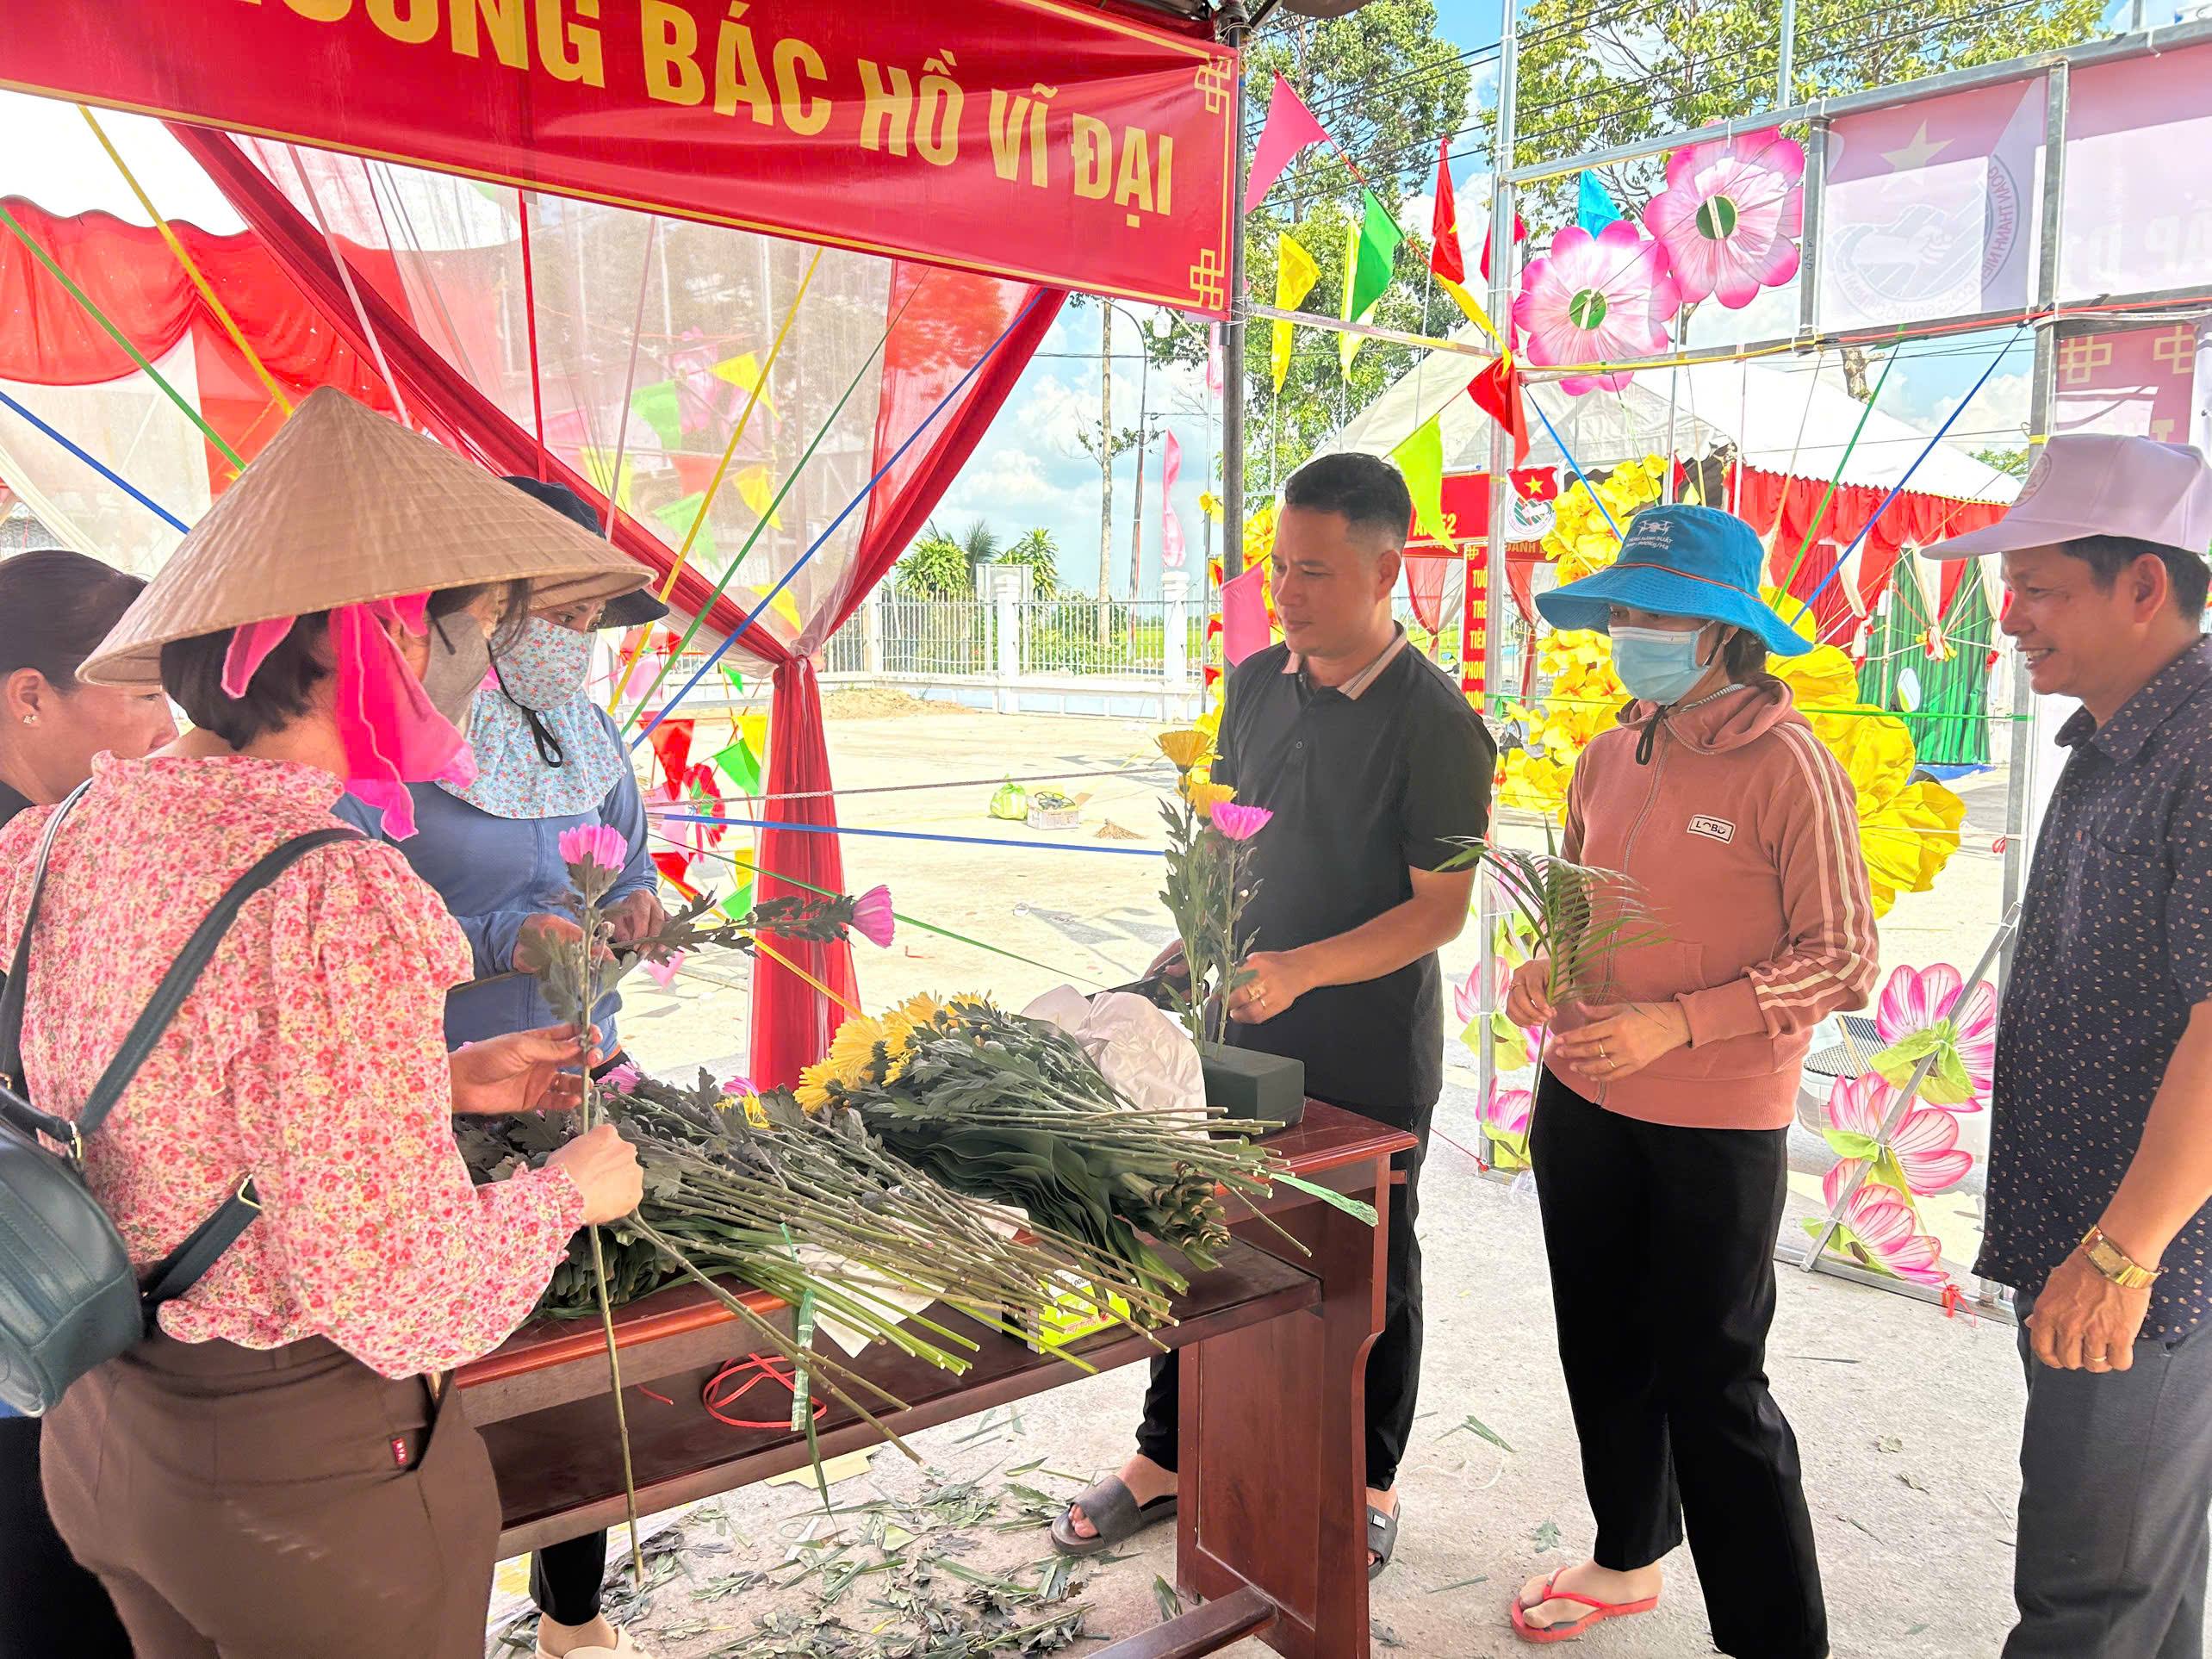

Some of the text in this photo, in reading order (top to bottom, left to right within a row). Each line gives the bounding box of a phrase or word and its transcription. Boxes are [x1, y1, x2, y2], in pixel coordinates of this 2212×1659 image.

[641, 0, 832, 136] BÁC
[857, 48, 965, 166] HỒ
[989, 83, 1059, 188] VĨ
[1071, 112, 1173, 228] ĐẠI
